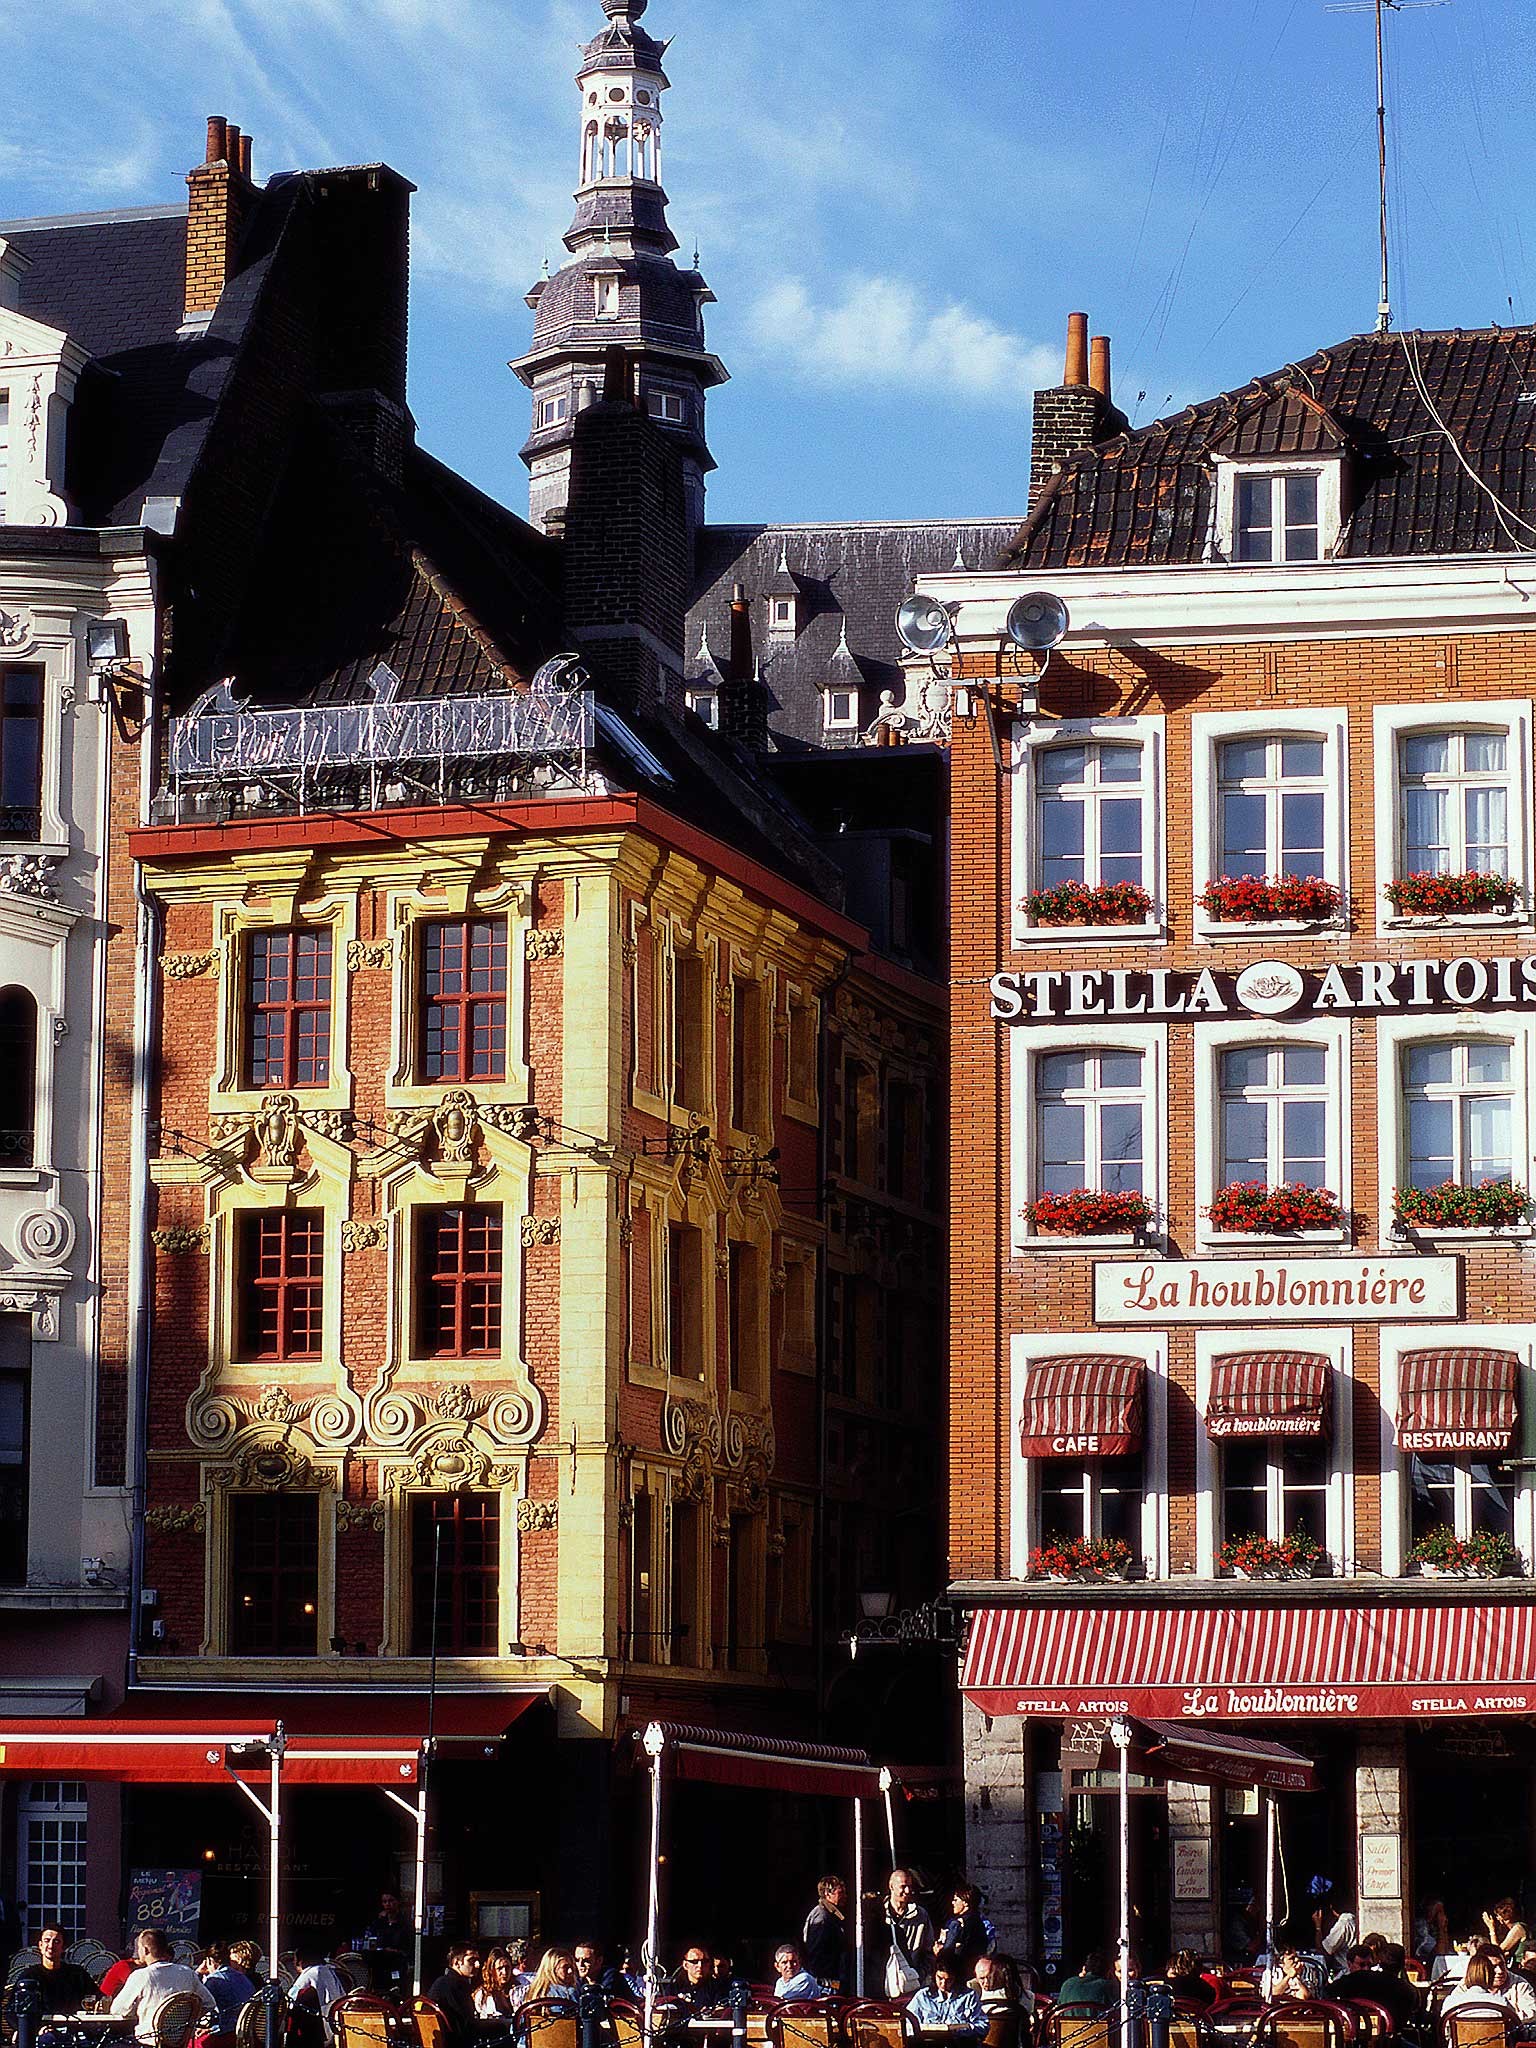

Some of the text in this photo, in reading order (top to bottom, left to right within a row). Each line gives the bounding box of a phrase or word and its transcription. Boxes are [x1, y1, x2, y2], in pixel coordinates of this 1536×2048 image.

[989, 967, 1228, 1018] STELLA
[1123, 1265, 1180, 1311] La
[1210, 1418, 1232, 1436] La
[1052, 1435, 1099, 1453] CAFE
[1402, 1431, 1512, 1449] RESTAURANT
[1016, 1700, 1129, 1713] STELLA ARTOIS
[1181, 1687, 1358, 1717] La houblonnière
[1411, 1696, 1527, 1711] STELLA ARTOIS
